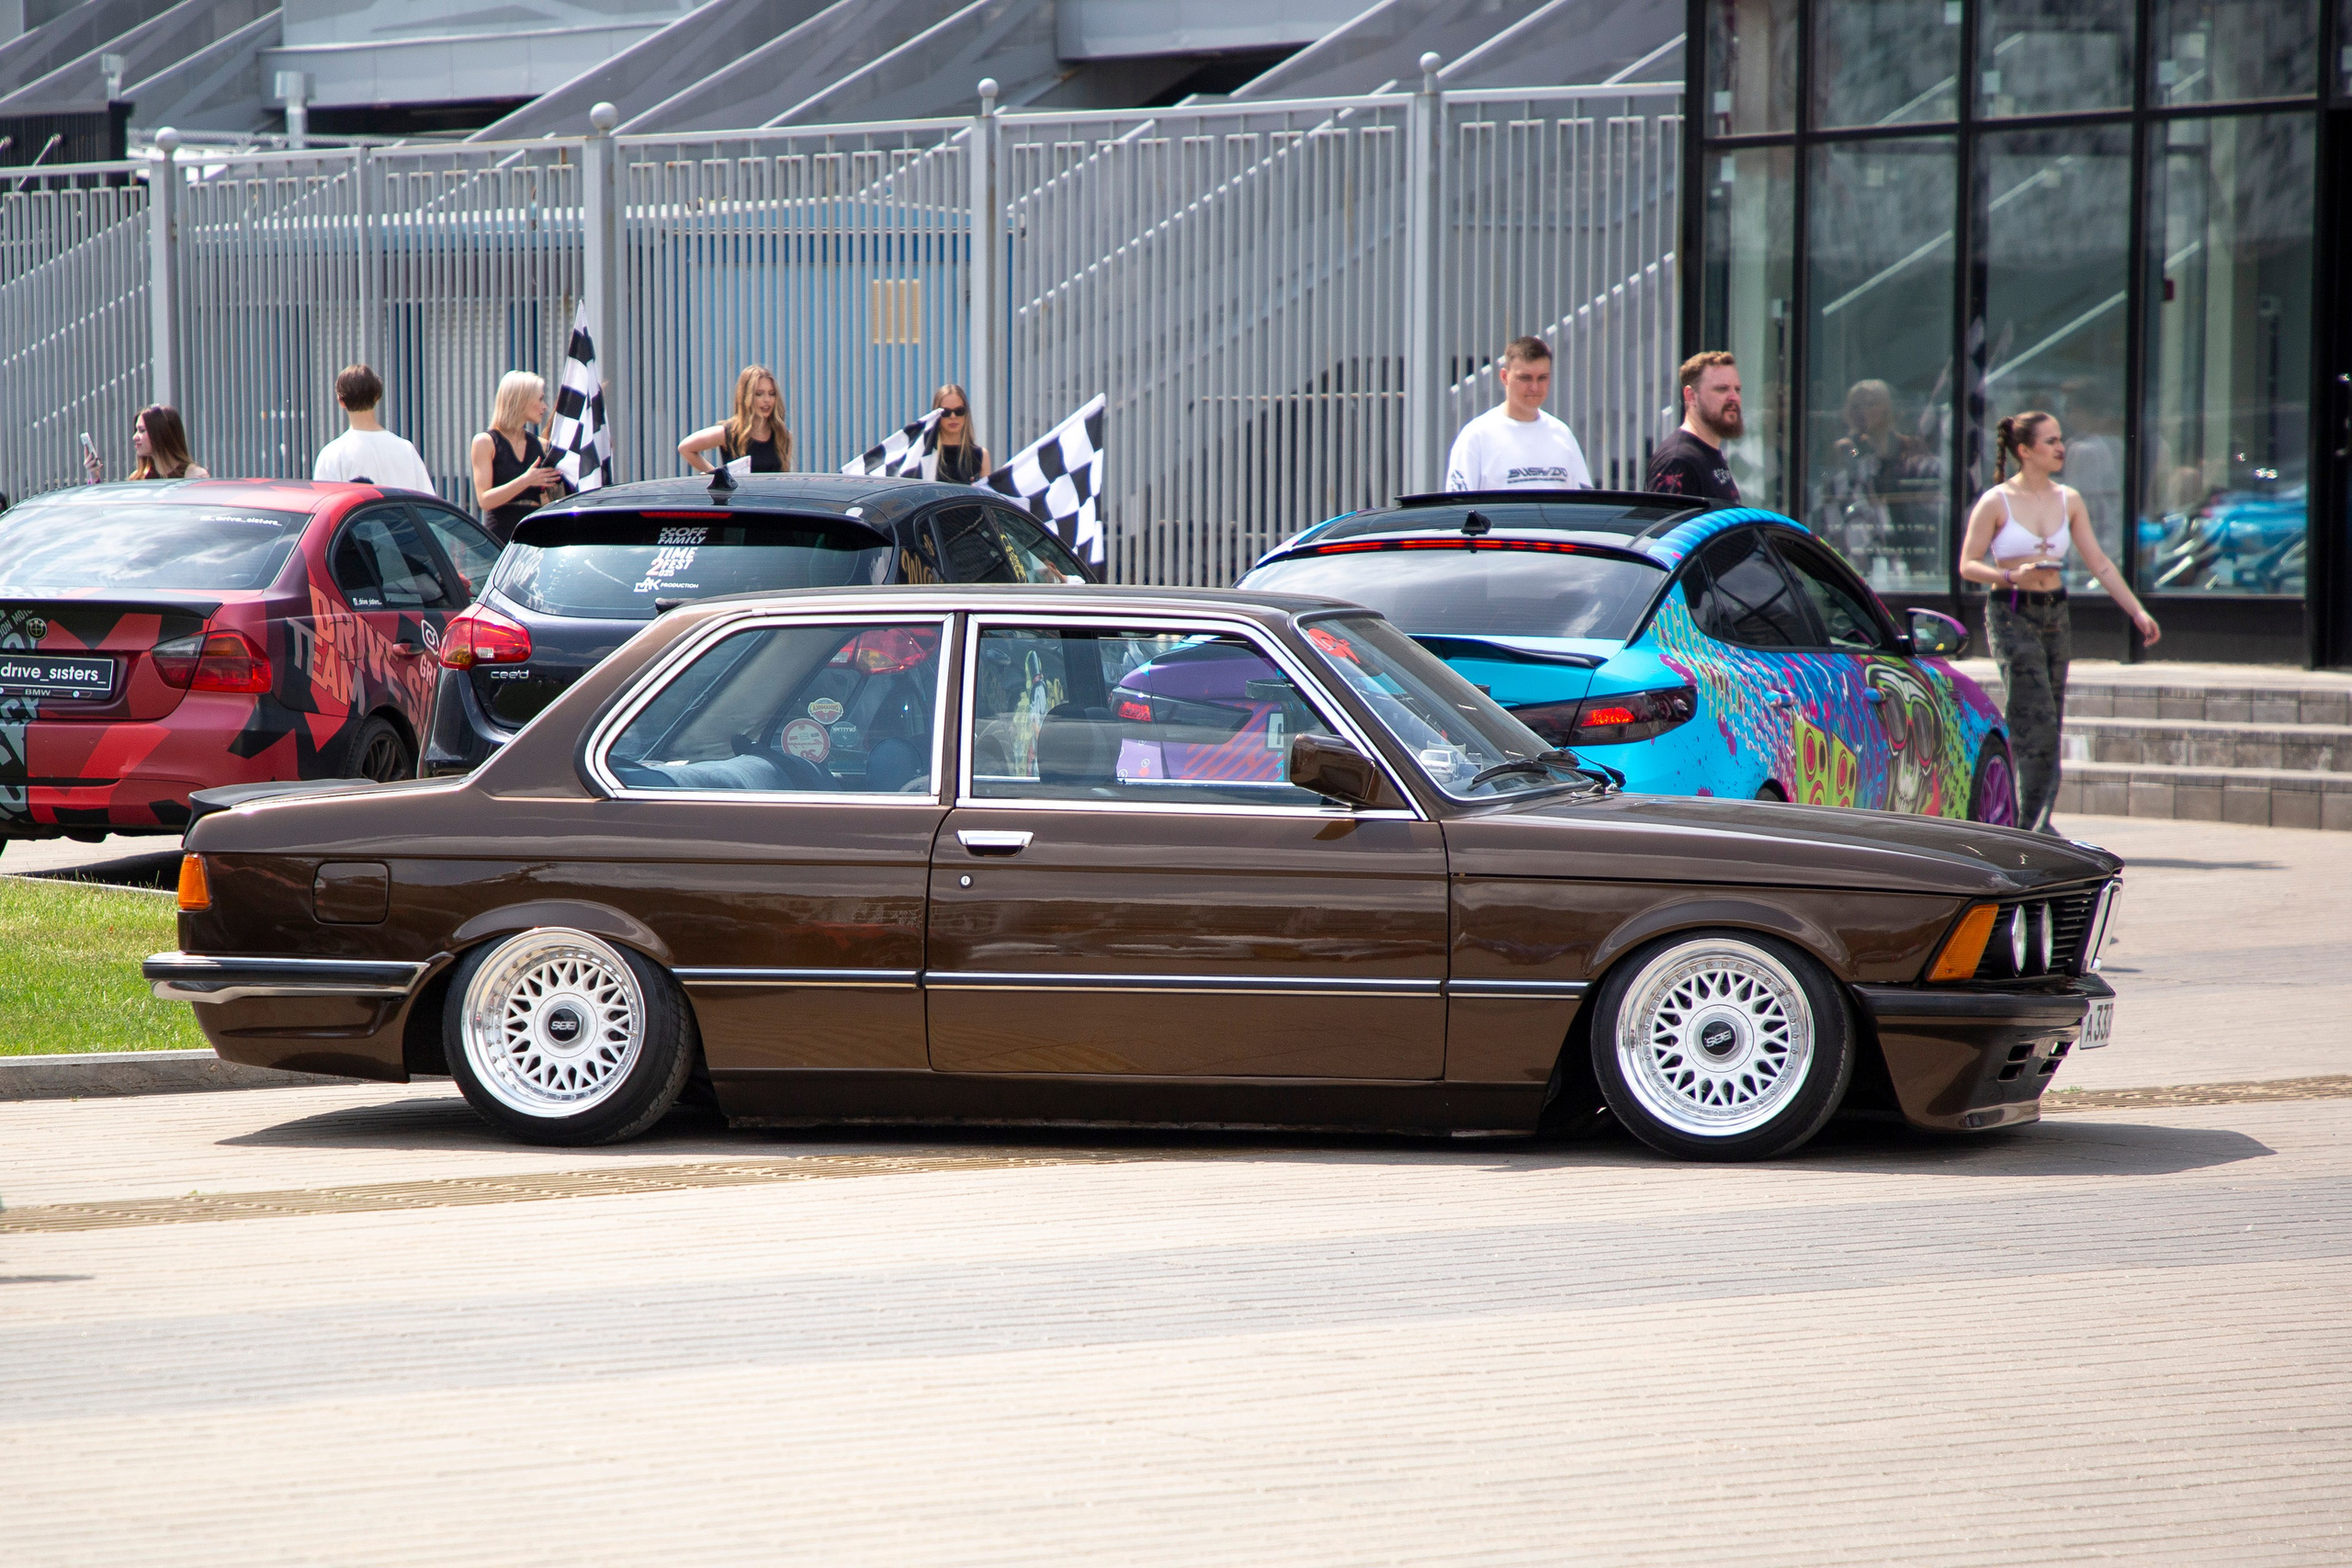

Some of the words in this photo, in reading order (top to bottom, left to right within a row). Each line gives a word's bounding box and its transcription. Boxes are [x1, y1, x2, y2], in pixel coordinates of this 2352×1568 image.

[657, 536, 707, 545] FAMILY
[657, 547, 698, 559] TIME
[308, 583, 402, 705] DRIVE
[286, 616, 367, 717] TEAM
[25, 688, 51, 696] BMW
